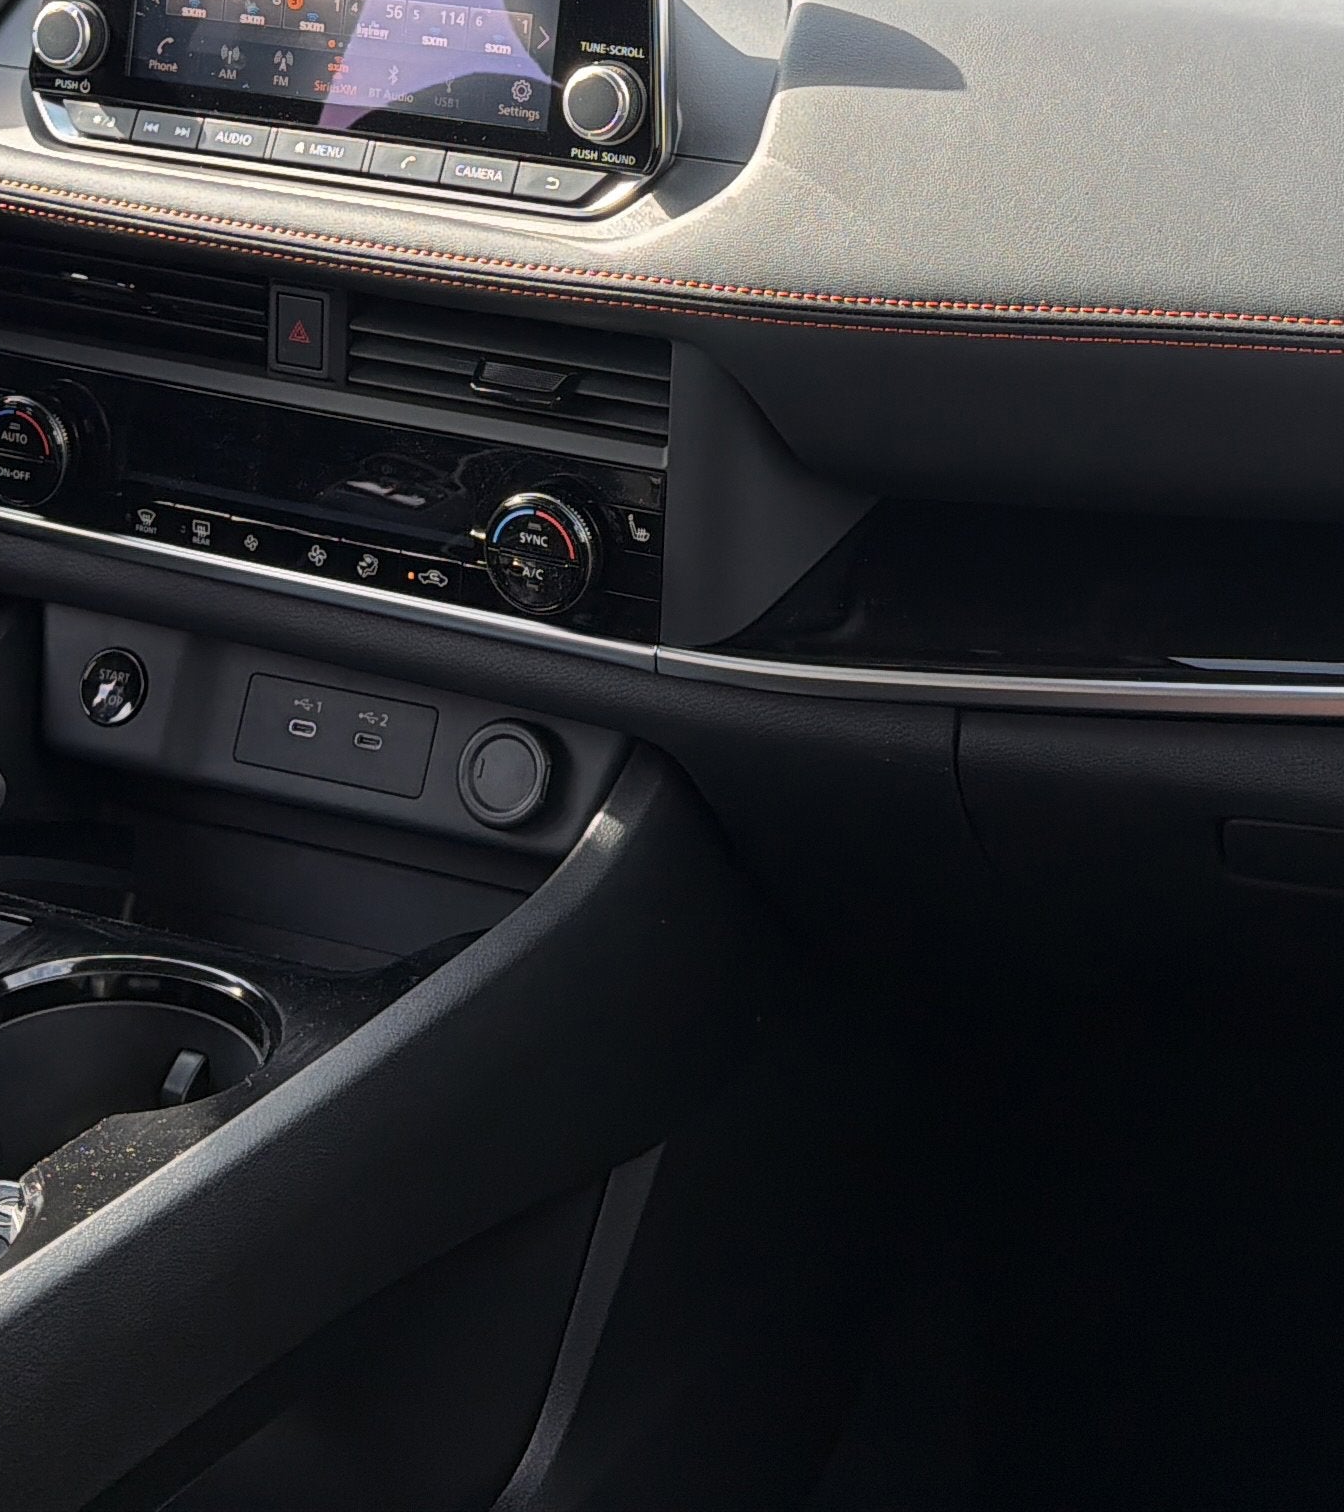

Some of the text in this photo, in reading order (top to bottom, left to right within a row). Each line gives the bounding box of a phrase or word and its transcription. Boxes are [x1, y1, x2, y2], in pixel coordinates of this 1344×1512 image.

[350, 1, 359, 14] 4
[385, 3, 403, 19] 56
[413, 9, 420, 20] 5
[440, 10, 465, 27] 114
[475, 16, 483, 27] 6
[148, 59, 179, 73] Phone
[218, 69, 237, 80] AM
[272, 75, 289, 87] FM
[54, 78, 78, 89] PUSH
[368, 87, 414, 104] BT Audio
[498, 103, 541, 120] Settings
[214, 130, 253, 147] AUDIO
[308, 142, 346, 159] MENU
[571, 146, 636, 166] PUSH SOUND
[454, 164, 503, 182] CAMERA
[0, 429, 28, 445] AUTO
[135, 523, 158, 535] FRONT
[192, 536, 210, 546] REAR
[519, 531, 549, 548] SYNC
[521, 566, 545, 581] A/C
[98, 668, 131, 683] START
[316, 701, 323, 713] 1
[379, 713, 389, 727] 2
